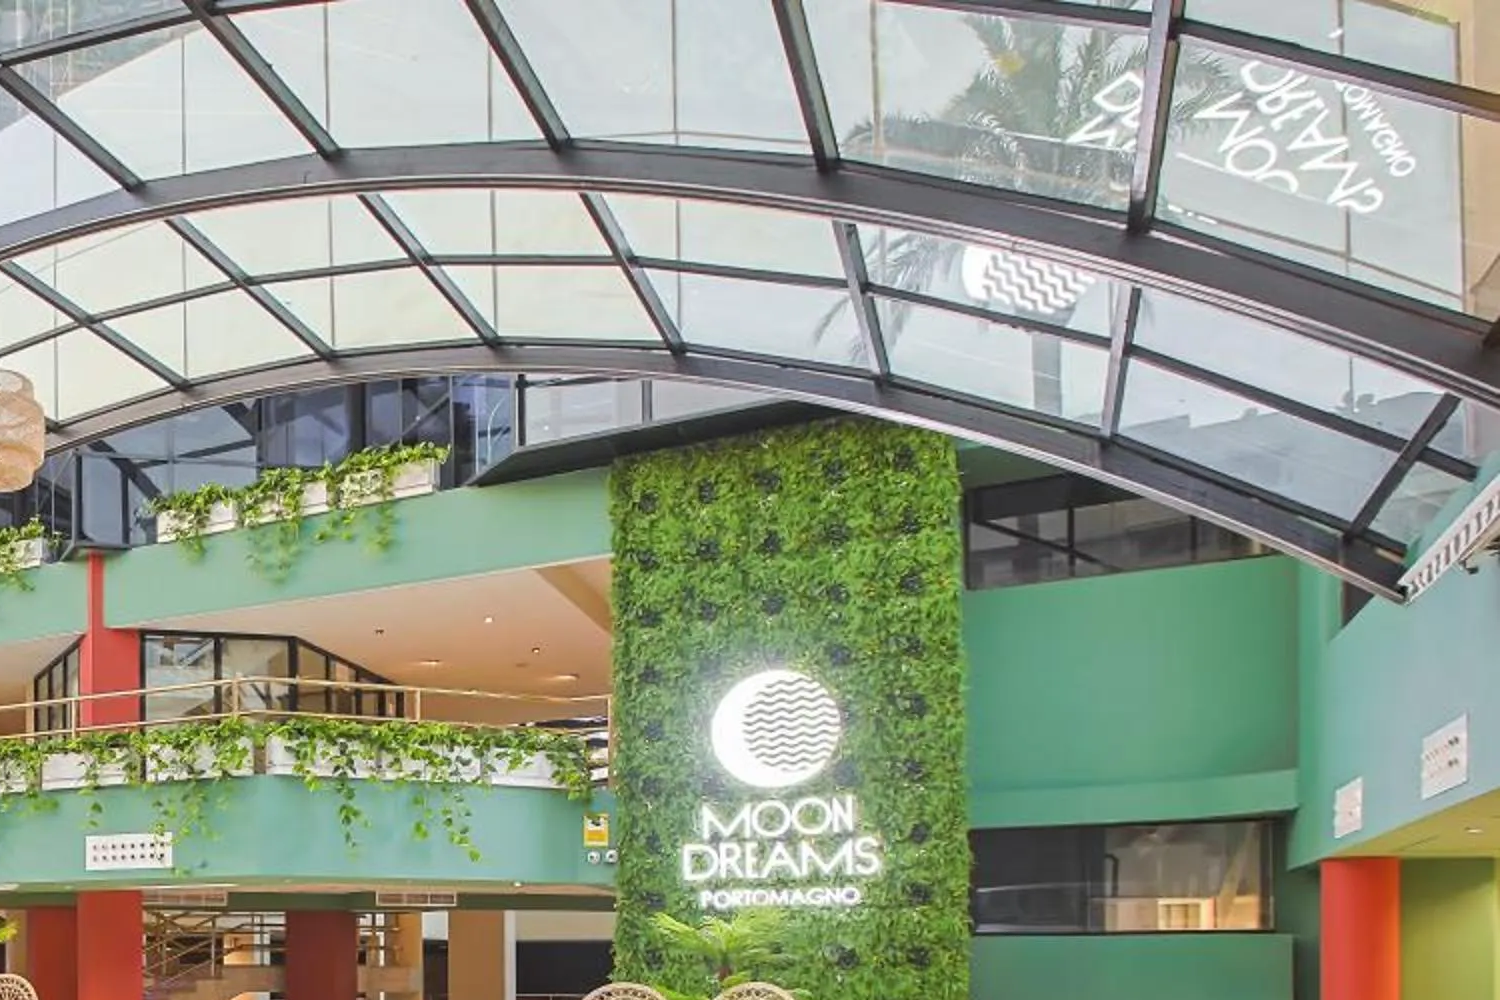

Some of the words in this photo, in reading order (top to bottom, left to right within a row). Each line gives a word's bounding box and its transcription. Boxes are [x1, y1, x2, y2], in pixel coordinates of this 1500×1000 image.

[701, 794, 856, 840] MOON
[682, 836, 882, 882] DREAMS
[701, 886, 862, 910] PORTOMAGNO
